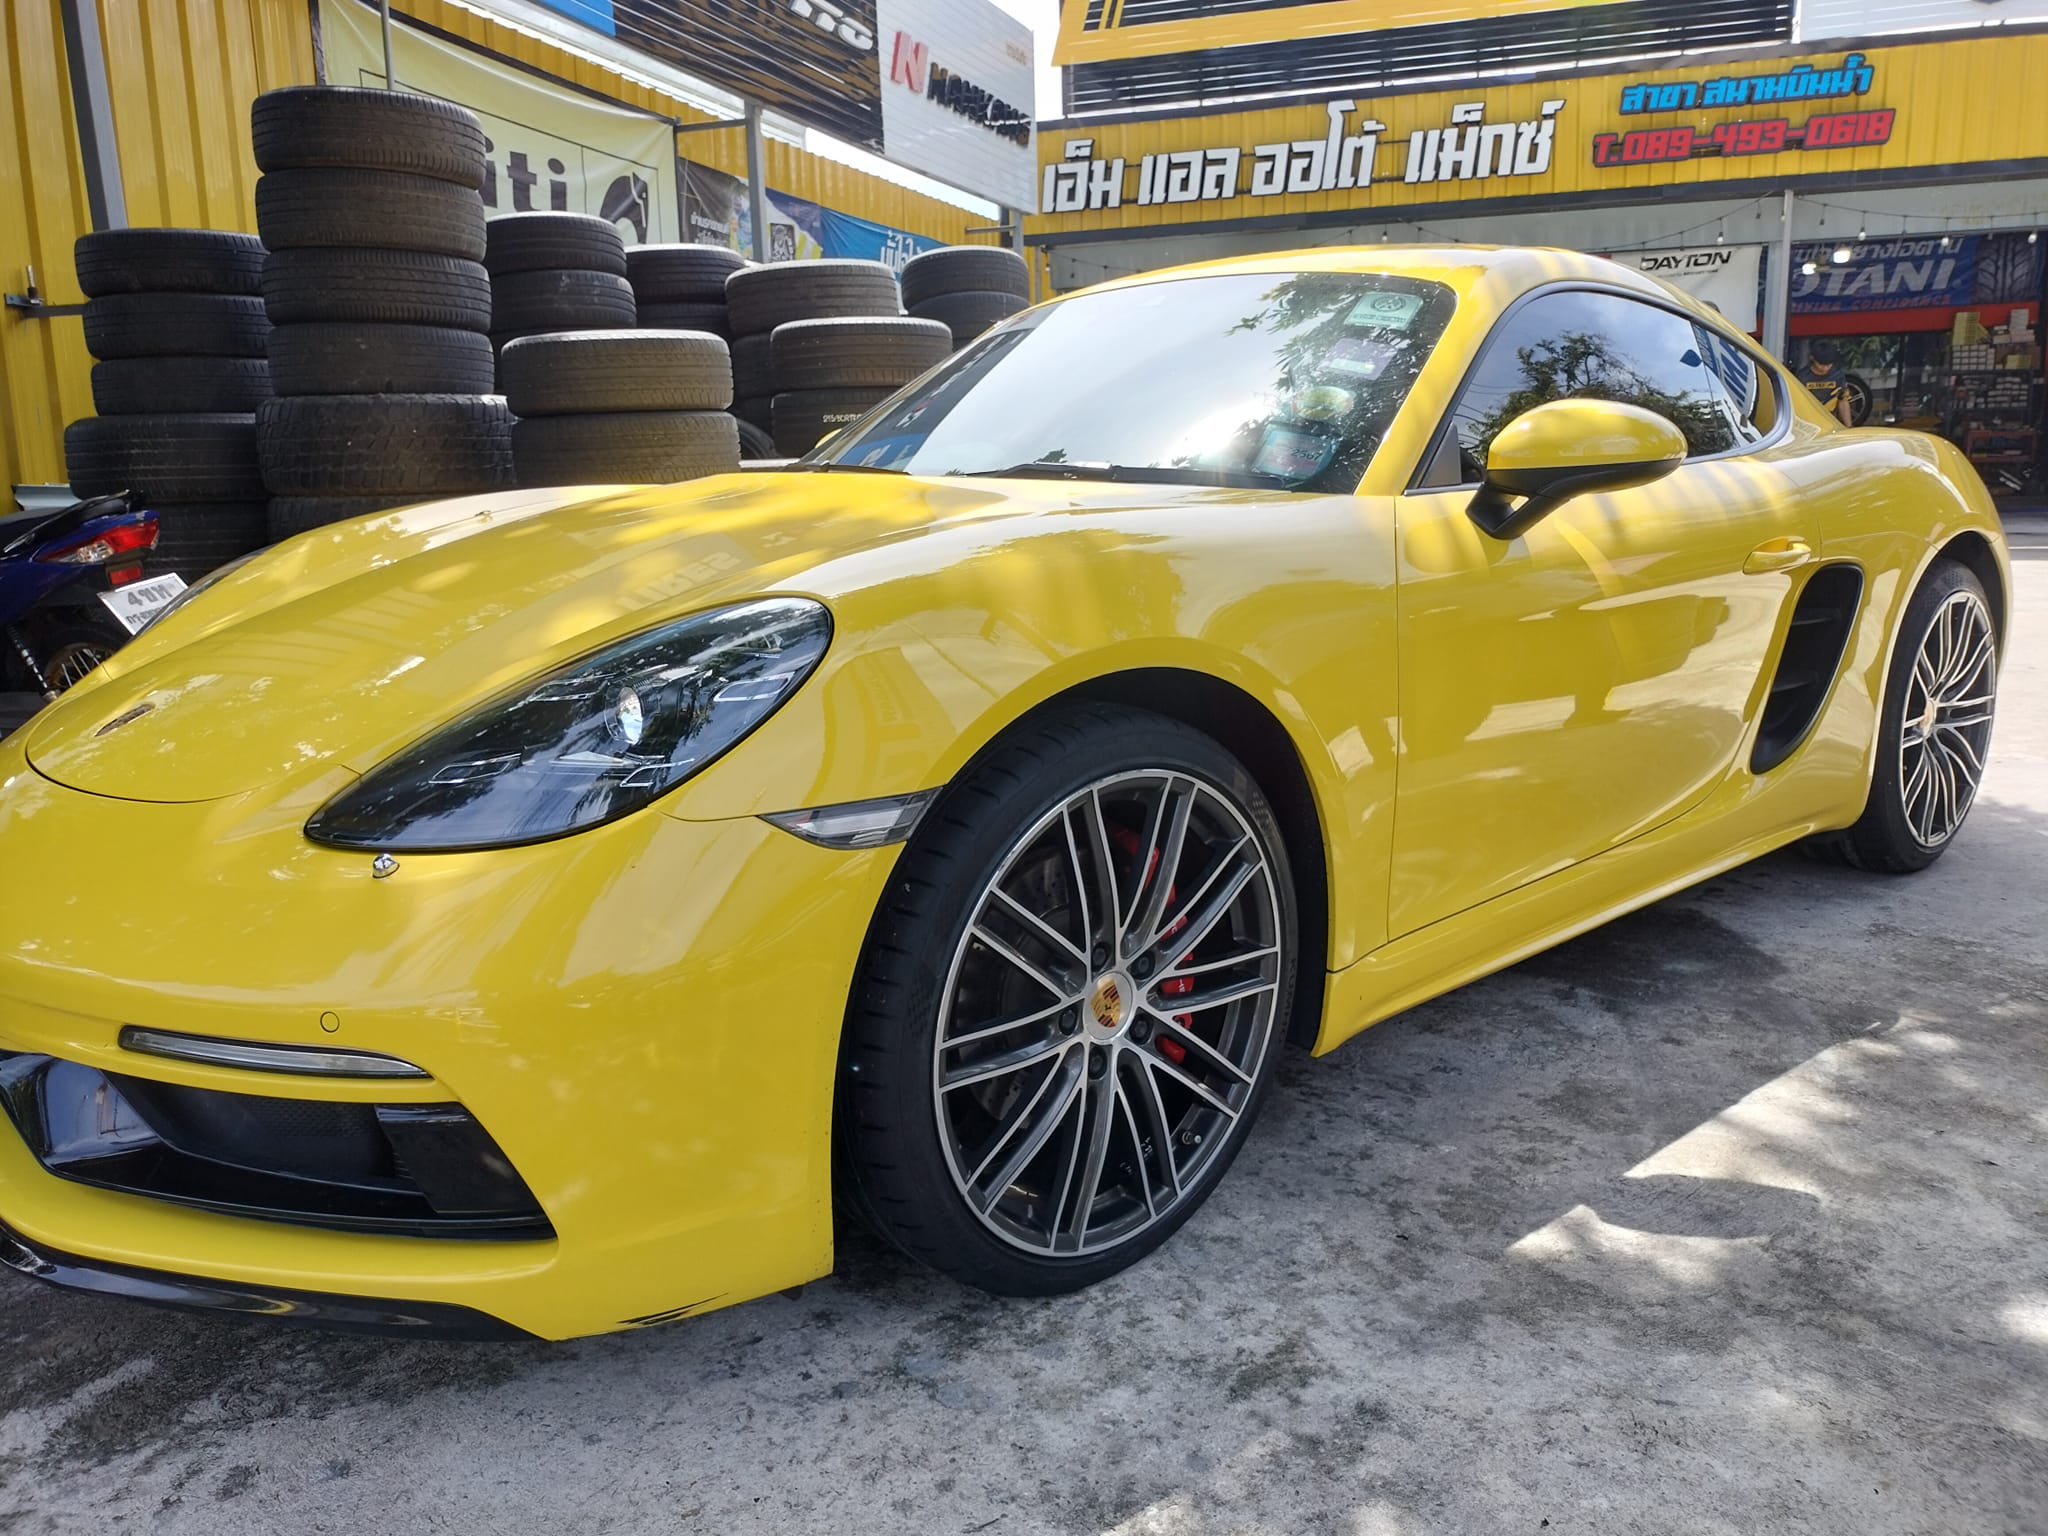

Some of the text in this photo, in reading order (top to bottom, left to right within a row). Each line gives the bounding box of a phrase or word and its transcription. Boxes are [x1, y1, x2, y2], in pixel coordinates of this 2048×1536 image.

[1620, 53, 1874, 114] สาขา สนามบินน้ำ
[1042, 99, 1566, 214] เอ็ม แอล ออโต้ แม็กซ์
[1593, 108, 1896, 168] T.089-493-0618
[1640, 251, 1732, 271] DAYTON
